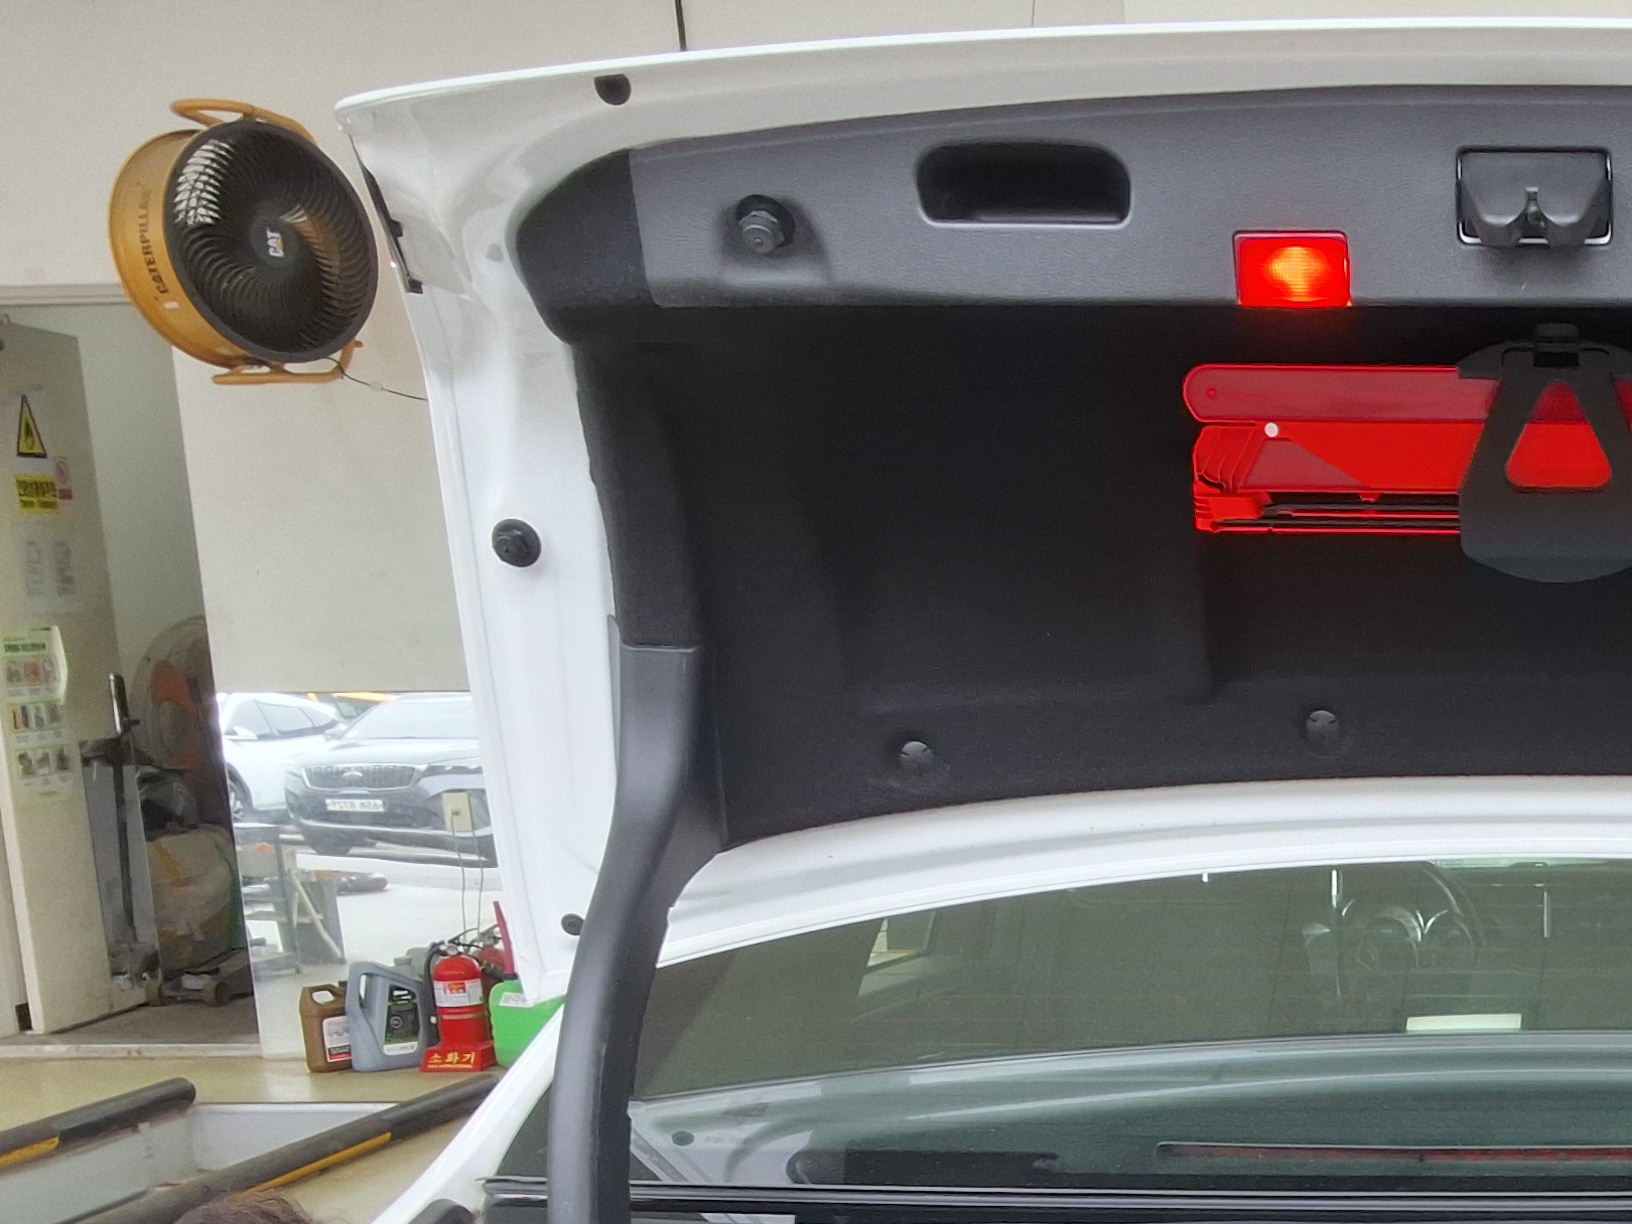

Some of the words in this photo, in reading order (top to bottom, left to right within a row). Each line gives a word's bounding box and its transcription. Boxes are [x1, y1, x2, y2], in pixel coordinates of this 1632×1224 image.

[138, 190, 169, 294] CATERPILLAR
[266, 227, 284, 257] CAT
[427, 1051, 476, 1064] 소화기
